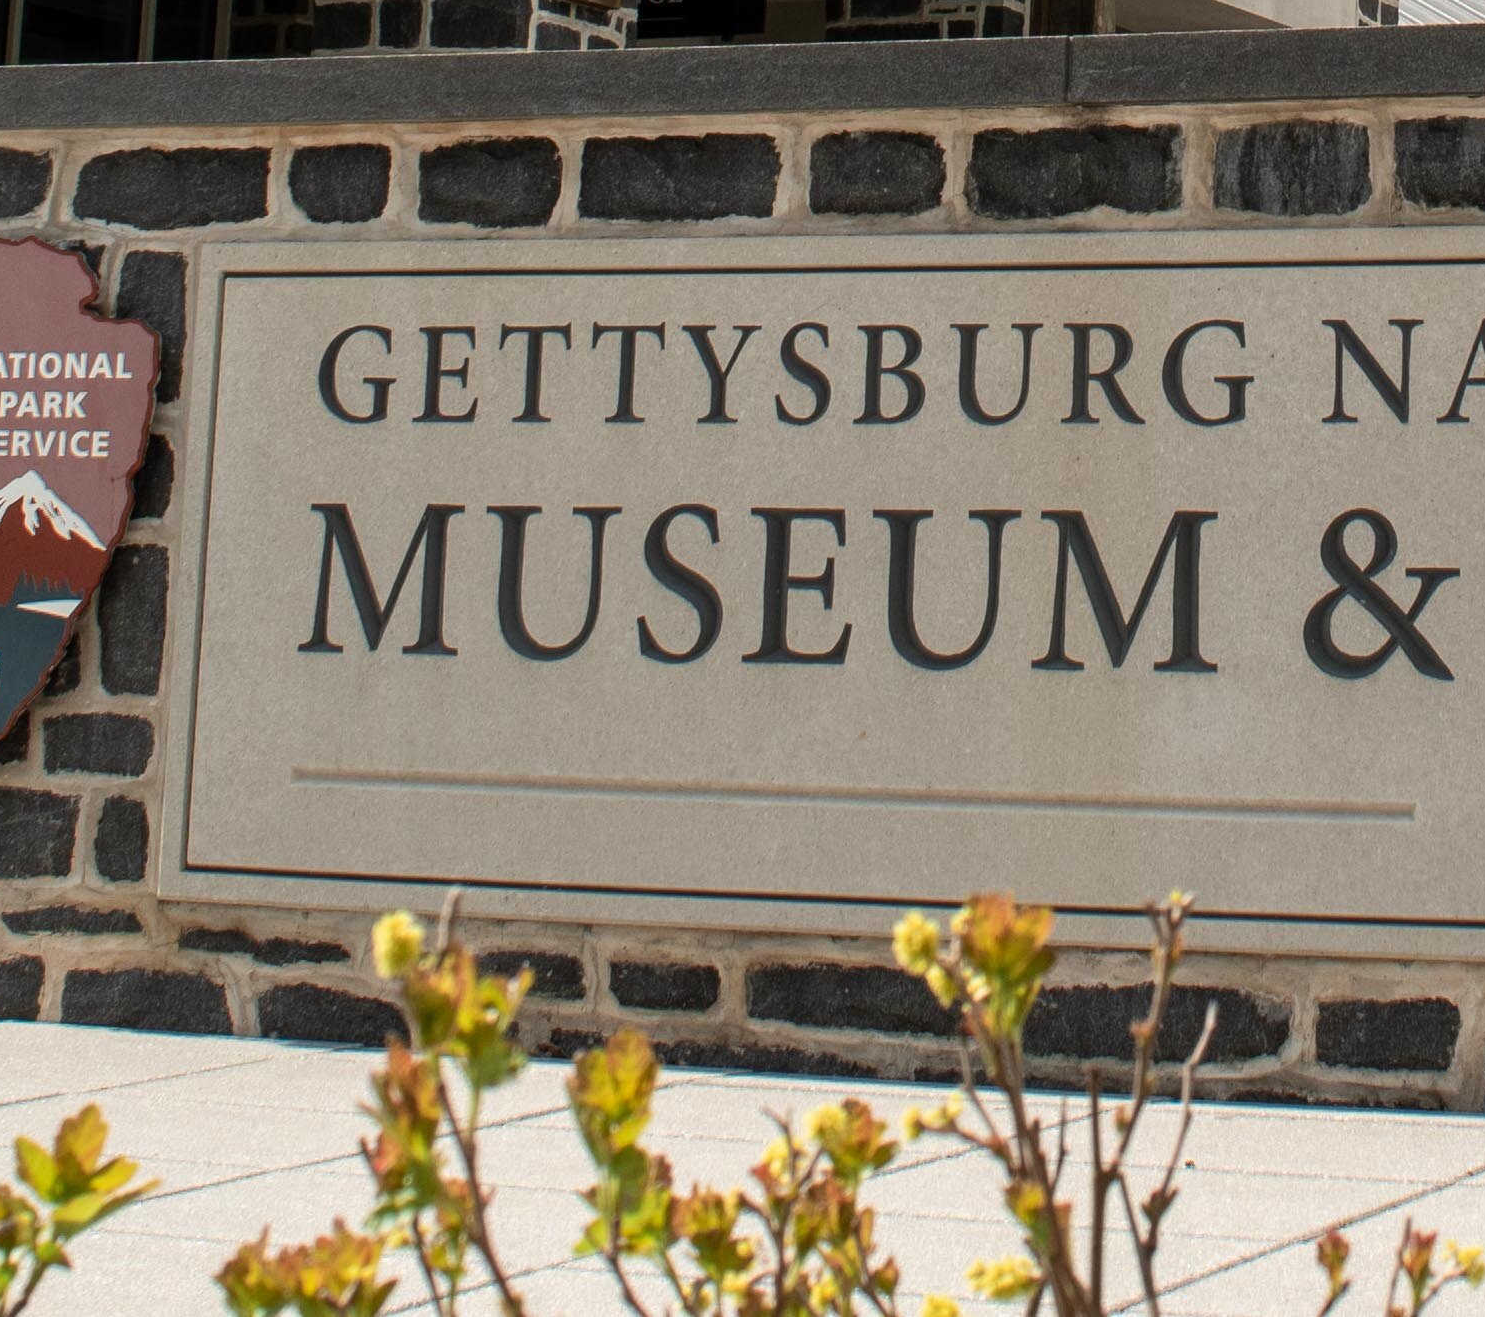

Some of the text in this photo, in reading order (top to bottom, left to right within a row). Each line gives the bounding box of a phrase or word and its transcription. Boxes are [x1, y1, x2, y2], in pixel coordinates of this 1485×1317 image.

[318, 319, 1255, 428] GETTYSBURG
[297, 503, 1219, 673] MUSEUM
[1302, 508, 1461, 681] &
